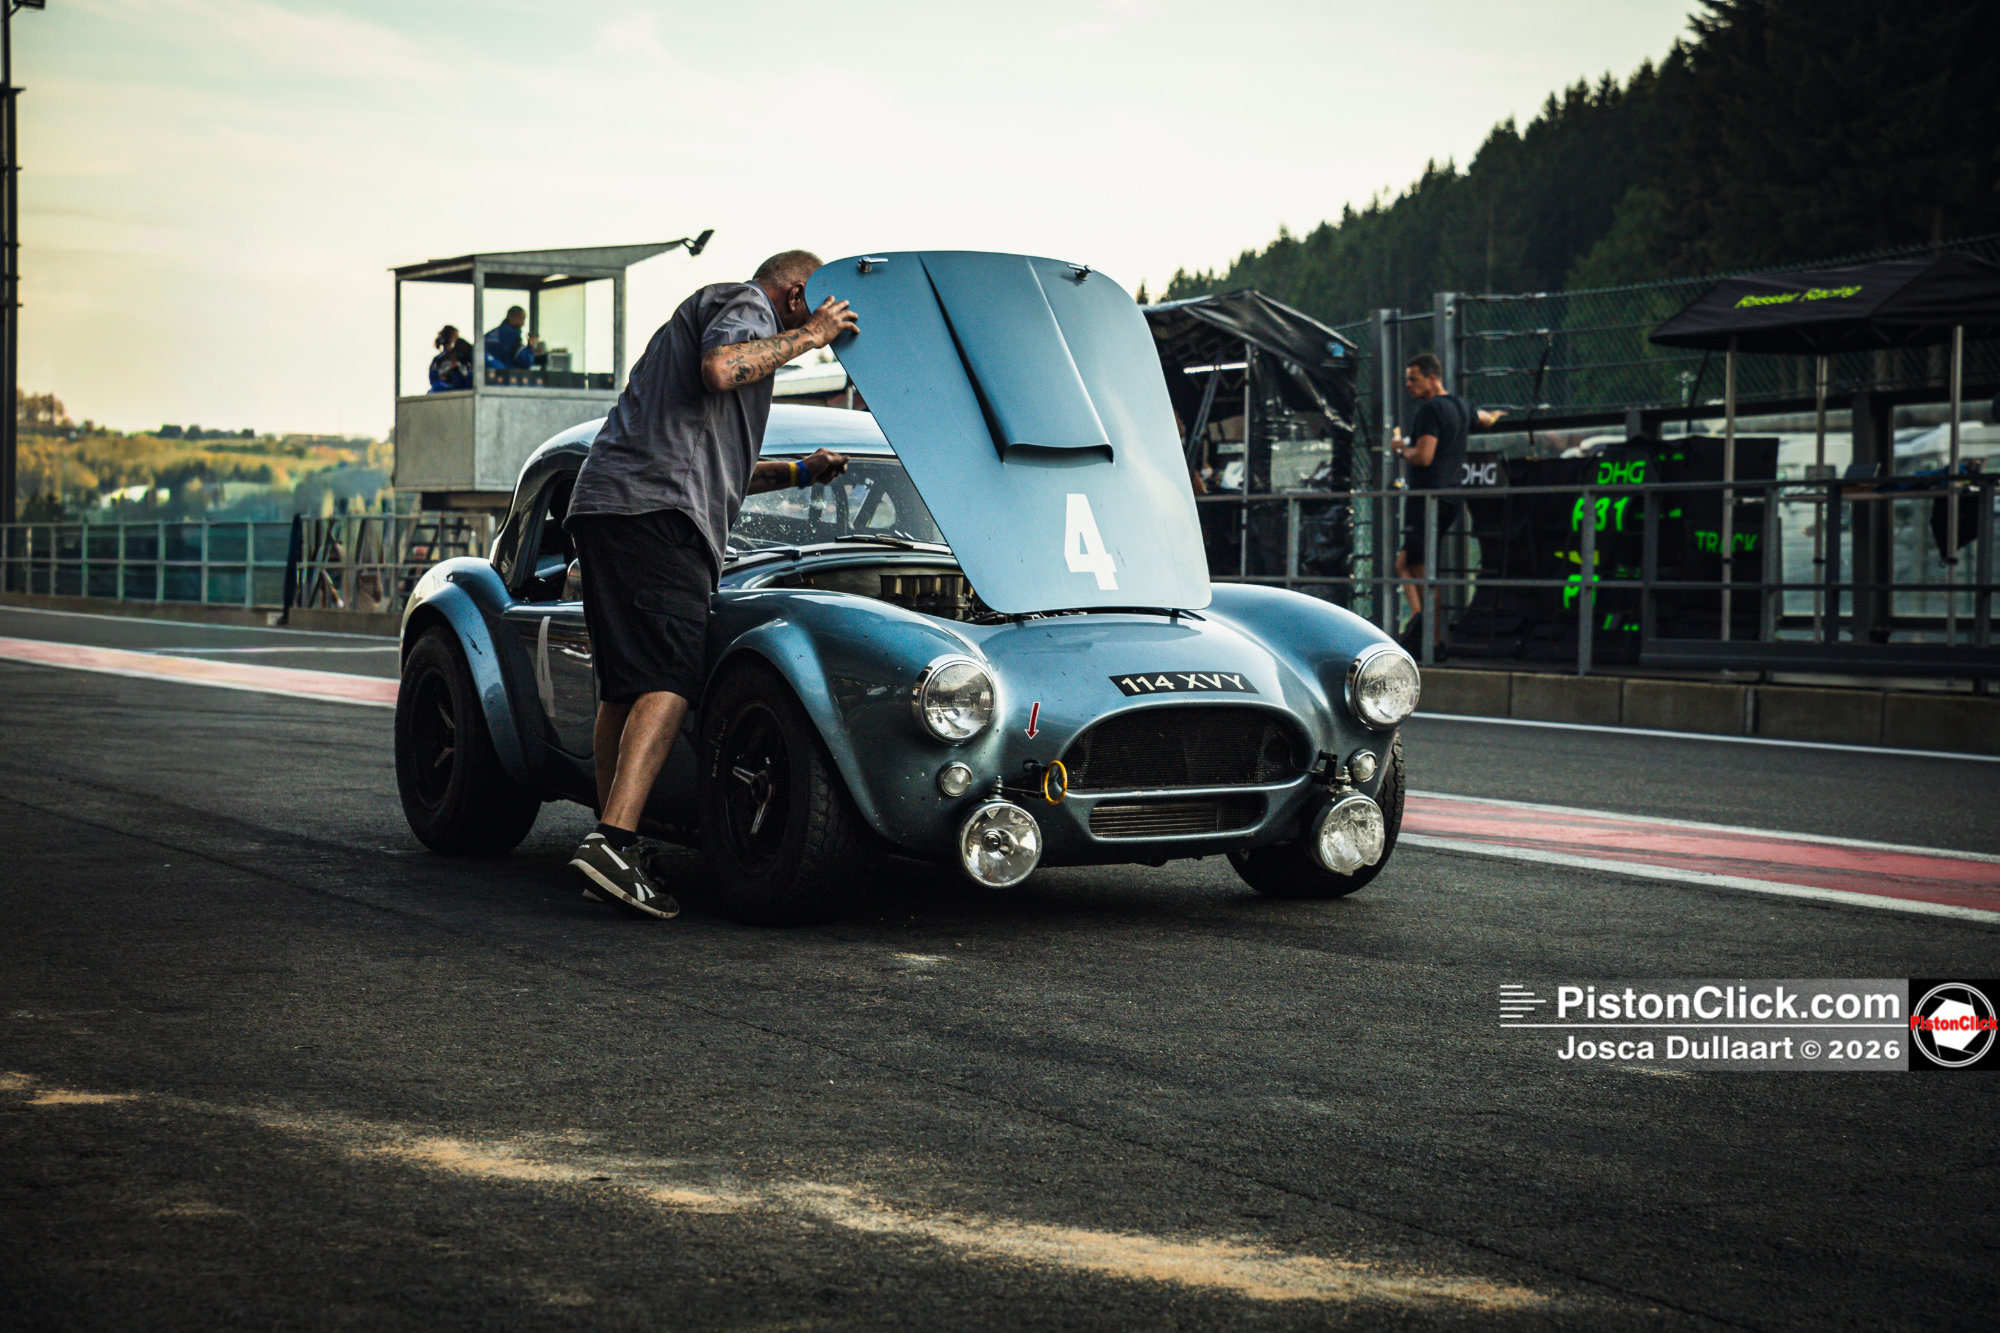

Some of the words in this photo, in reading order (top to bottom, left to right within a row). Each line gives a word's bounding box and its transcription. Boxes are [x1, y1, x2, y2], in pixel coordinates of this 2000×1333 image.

[1597, 460, 1647, 485] DHG
[1064, 494, 1119, 590] 4
[1695, 530, 1758, 553] TRCK
[1121, 674, 1175, 693] 114
[1176, 673, 1245, 690] XVY
